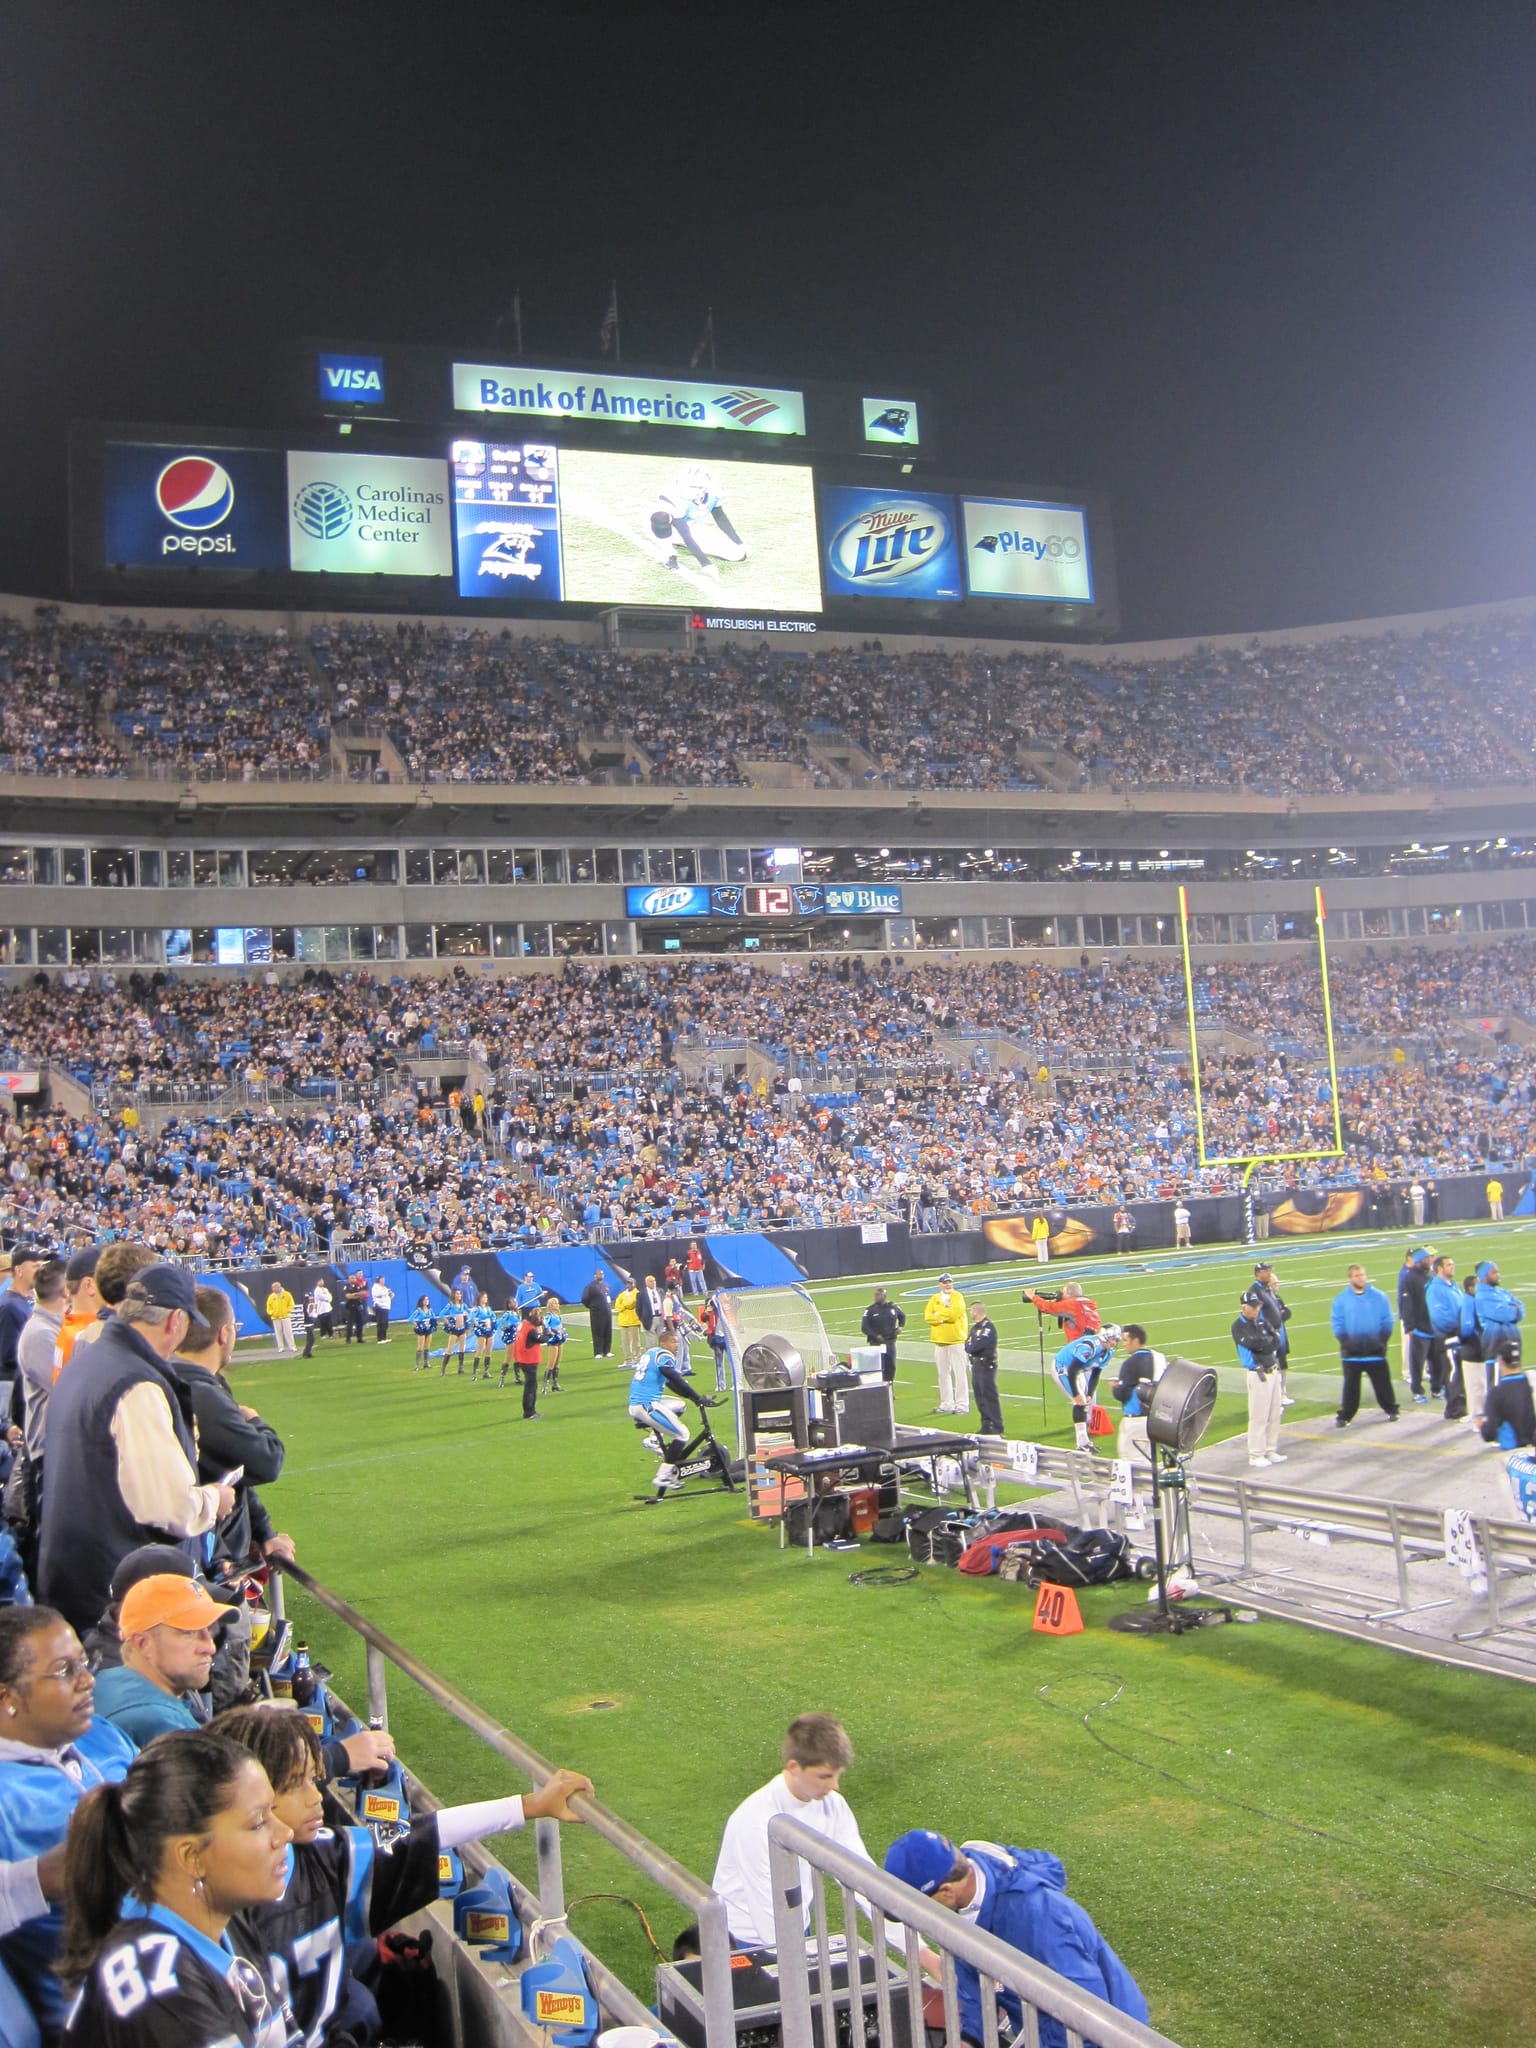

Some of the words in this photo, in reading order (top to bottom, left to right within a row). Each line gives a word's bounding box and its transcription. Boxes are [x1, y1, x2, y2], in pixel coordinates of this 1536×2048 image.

[326, 368, 381, 390] VISA
[480, 379, 554, 408] Bank
[555, 385, 586, 411] of
[591, 387, 705, 420] America
[356, 484, 444, 505] Carolinas
[357, 505, 433, 524] Medical
[860, 510, 919, 533] Miller
[358, 525, 420, 544] Center
[851, 525, 935, 578] Lite
[706, 618, 765, 630] MITSUBISHI
[766, 620, 817, 633] ELECTRIC
[759, 888, 789, 913] 12
[857, 890, 900, 907] Blue
[1038, 1588, 1065, 1628] 40
[101, 1932, 181, 2018] 87
